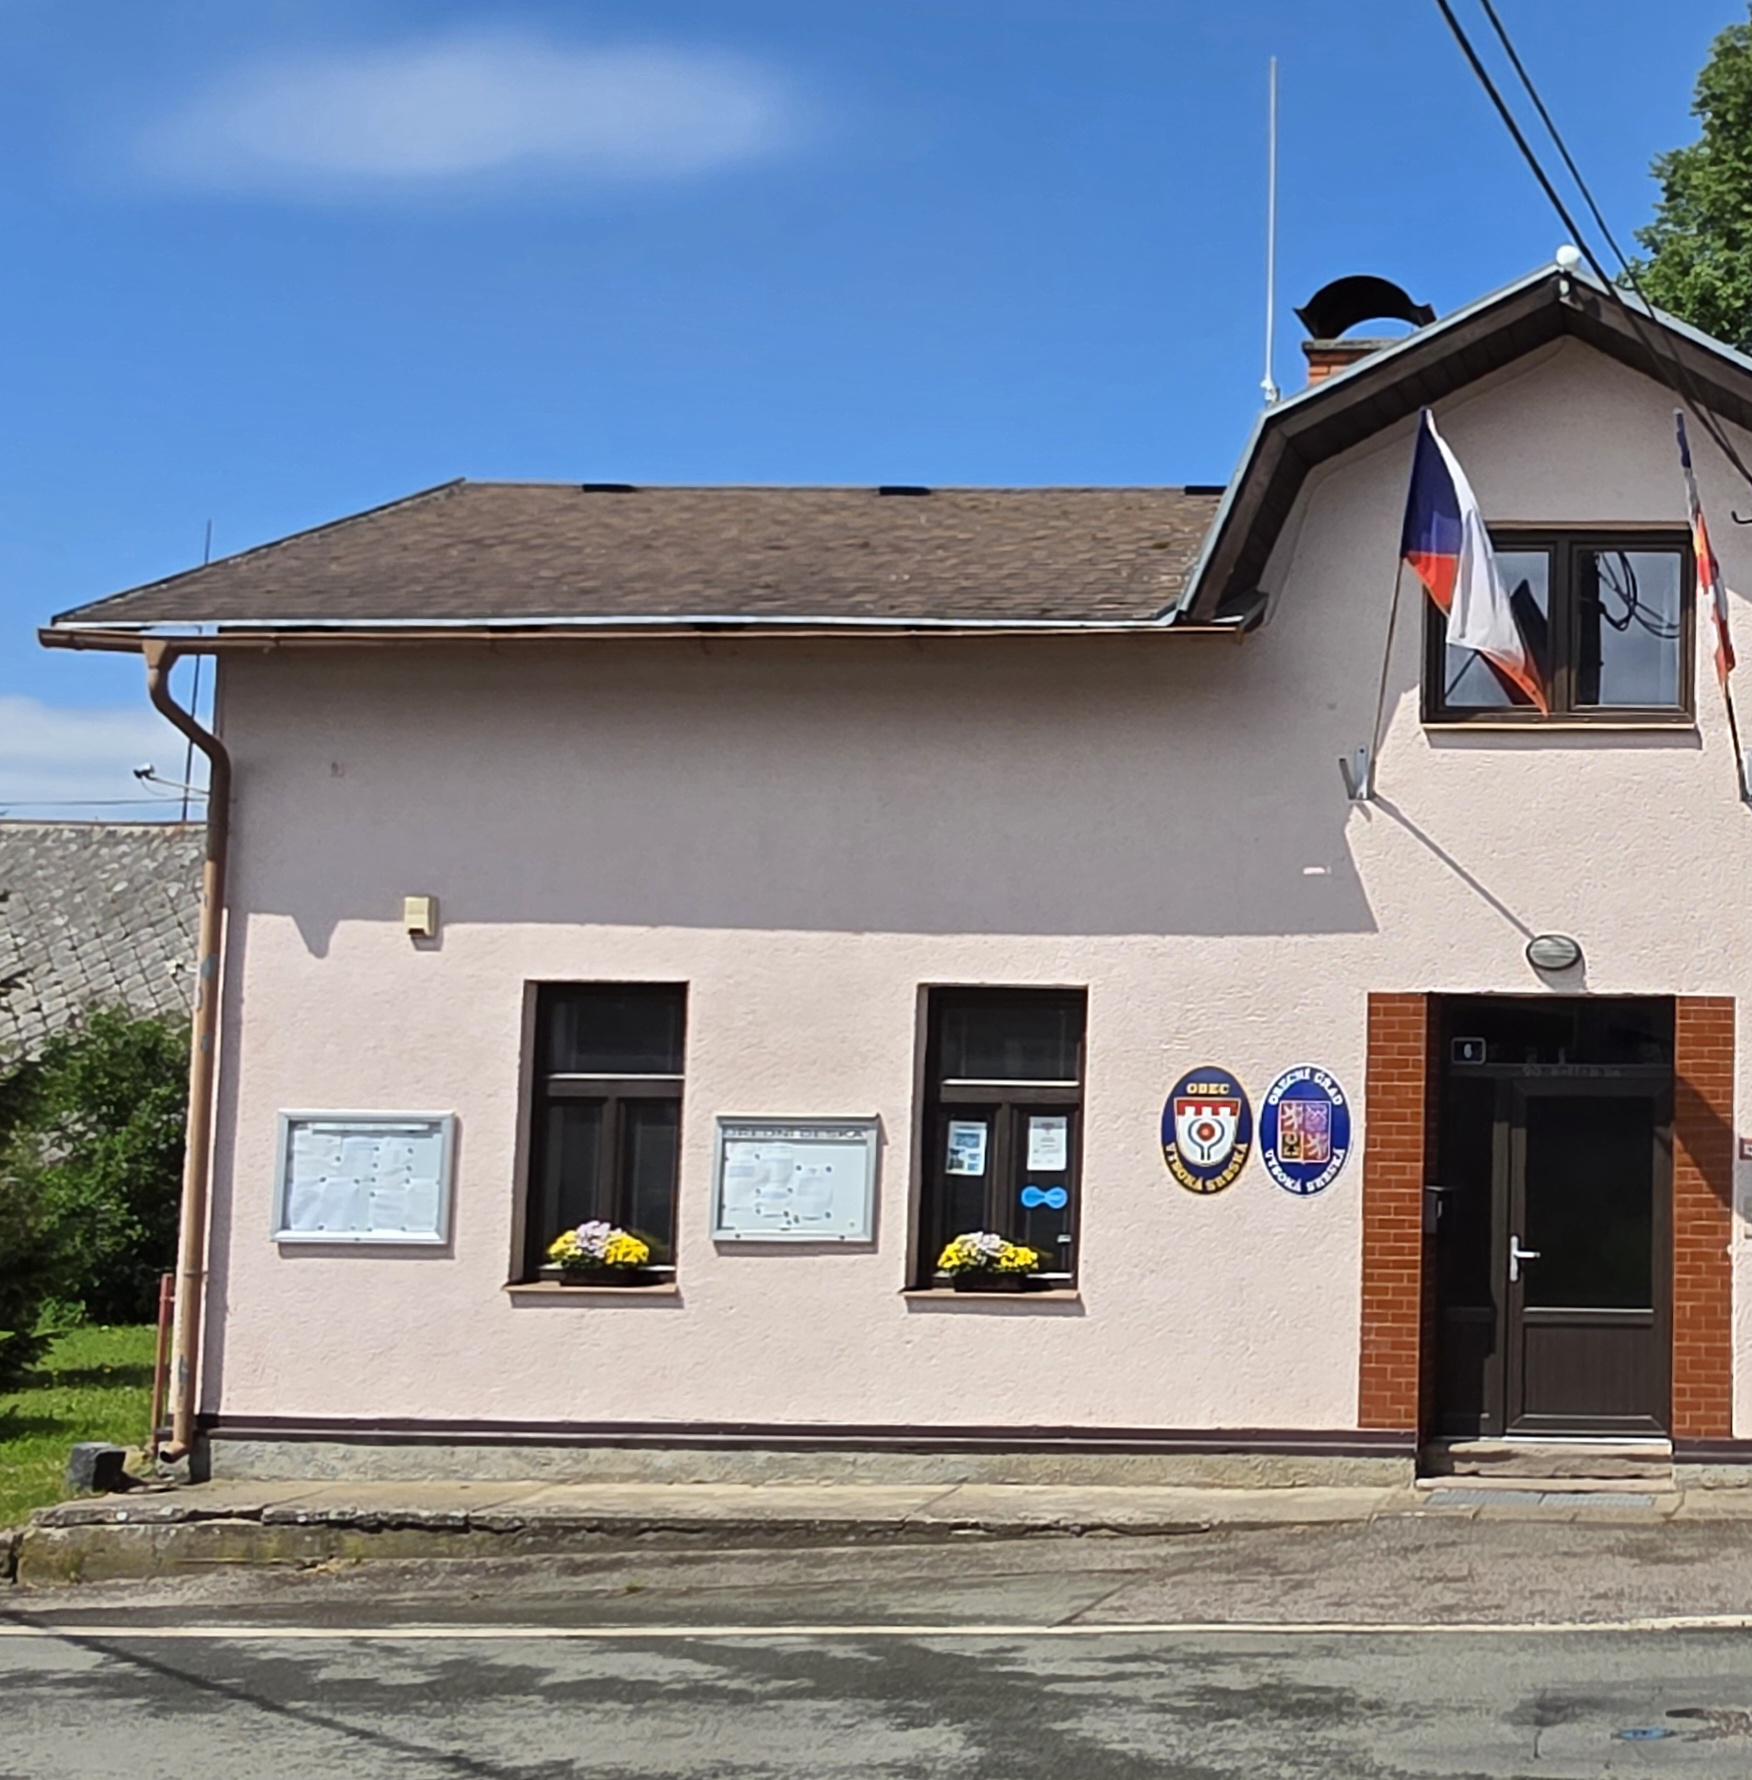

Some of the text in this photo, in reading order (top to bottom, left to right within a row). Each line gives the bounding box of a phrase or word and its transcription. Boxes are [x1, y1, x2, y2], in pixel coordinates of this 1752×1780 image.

[1186, 1083, 1230, 1095] OBEC
[1165, 1142, 1249, 1191] VYSOKÁ SRBSKÁ
[1264, 1148, 1301, 1192] VYSOKÁ
